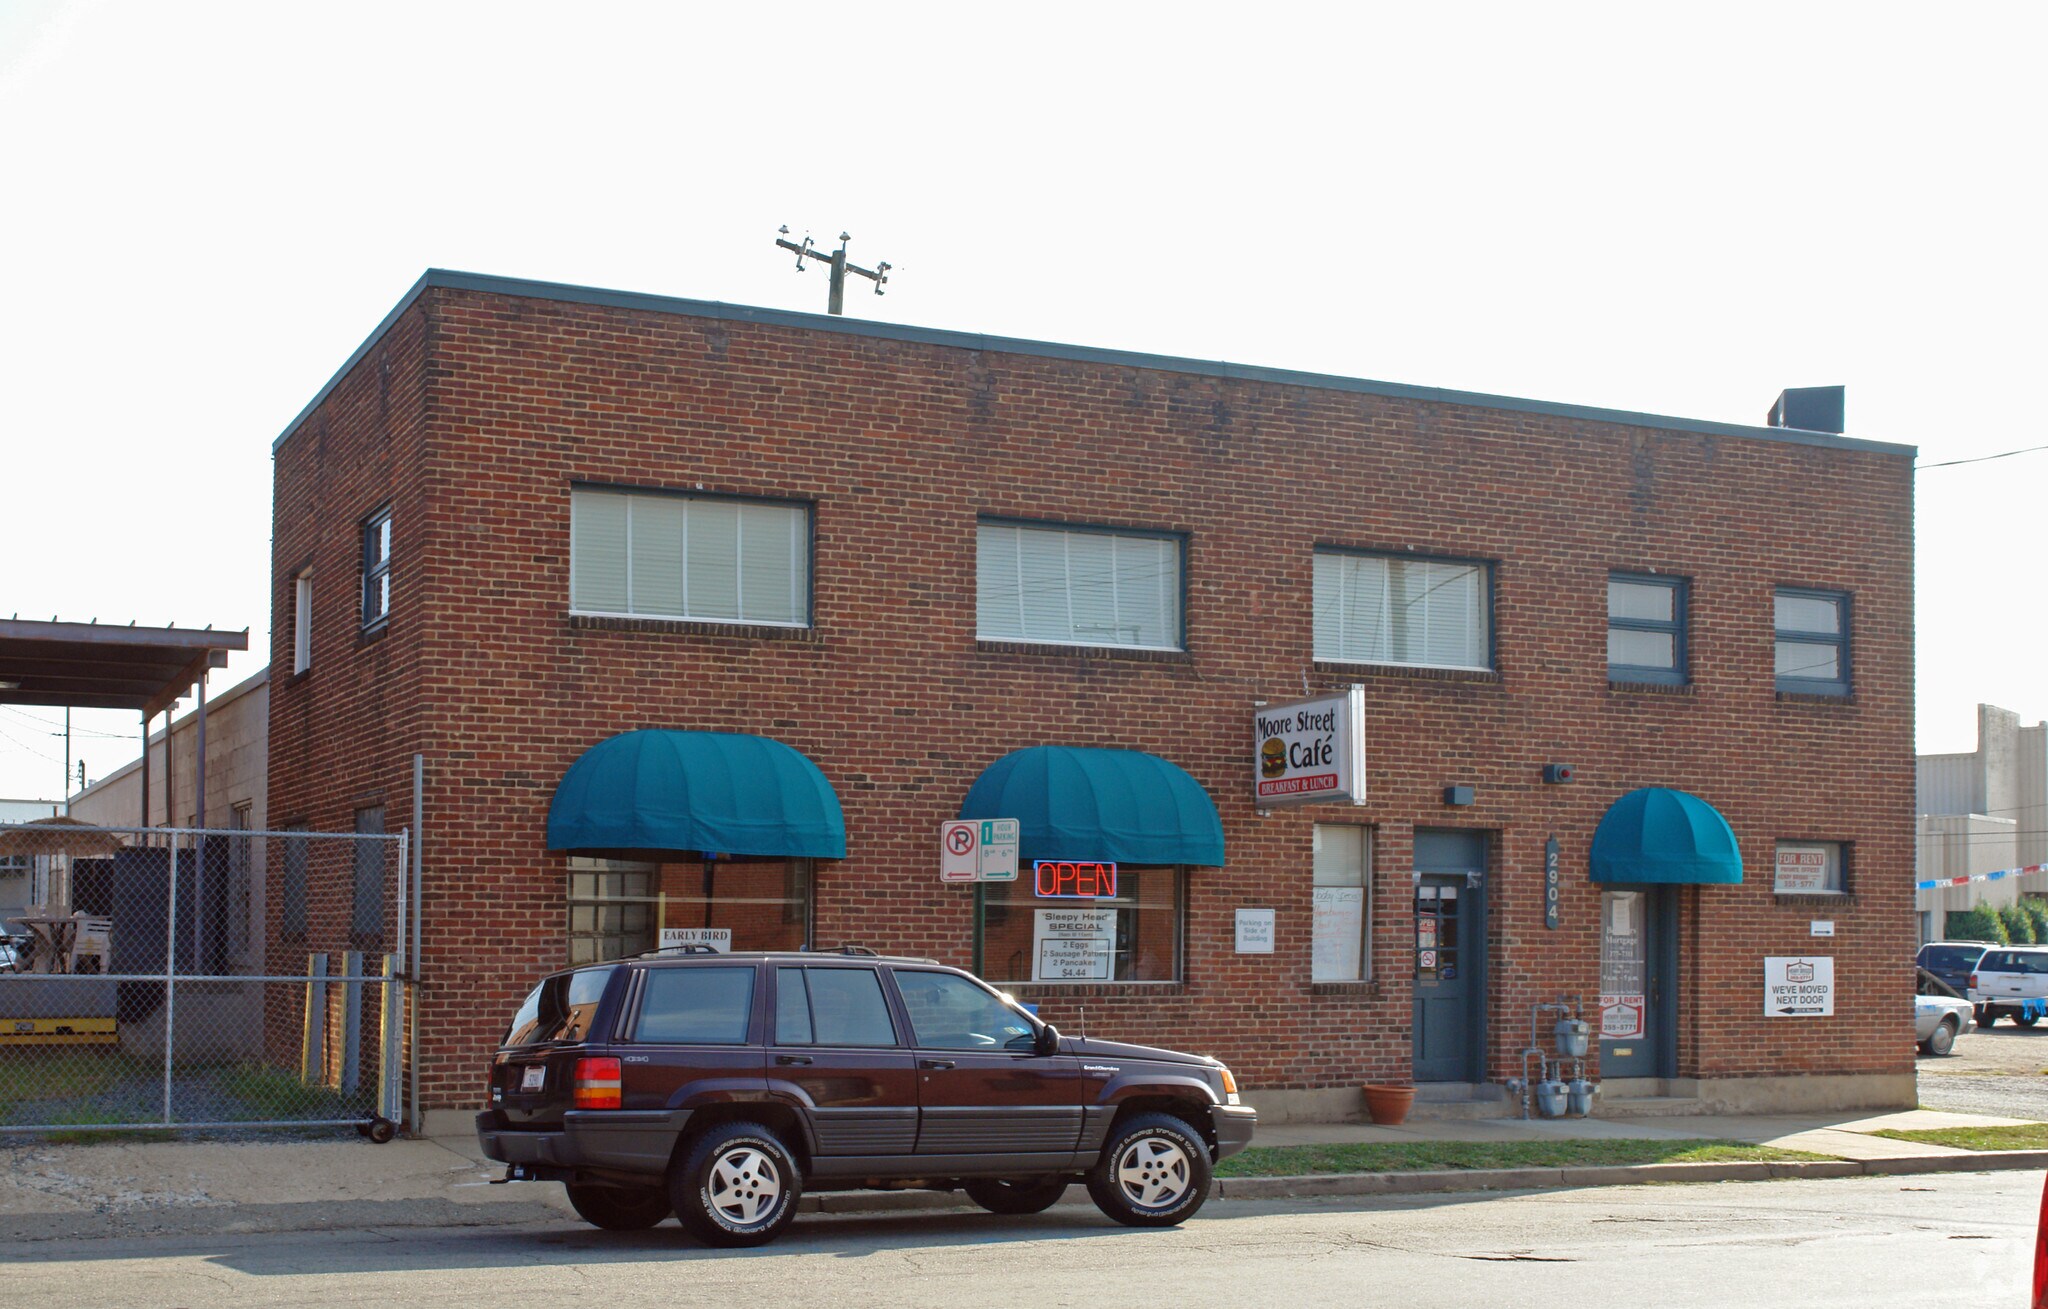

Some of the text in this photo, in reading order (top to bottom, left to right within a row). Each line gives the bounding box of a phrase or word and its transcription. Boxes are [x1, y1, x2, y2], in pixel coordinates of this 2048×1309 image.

[1257, 708, 1335, 742] Moore Street
[1289, 734, 1333, 769] Café
[1261, 776, 1334, 795] BREAKFAST & LUNCH
[1779, 853, 1822, 865] FOR RENT
[1037, 862, 1115, 896] OPEN
[1549, 852, 1558, 920] 2904
[1042, 912, 1111, 922] "Sleepy Head"
[1239, 919, 1262, 927] Parking
[664, 930, 728, 940] EARLY BIRD
[1243, 934, 1268, 943] Building
[1069, 941, 1089, 949] Eggs
[1049, 950, 1081, 958] Sausage
[1062, 968, 1087, 977] $4.44
[1771, 985, 1828, 994] WE'VE MOVED
[1600, 996, 1643, 1004] FOR RENT
[1776, 996, 1824, 1005] NEXT DOOR
[1603, 1023, 1636, 1031] 355-5771
